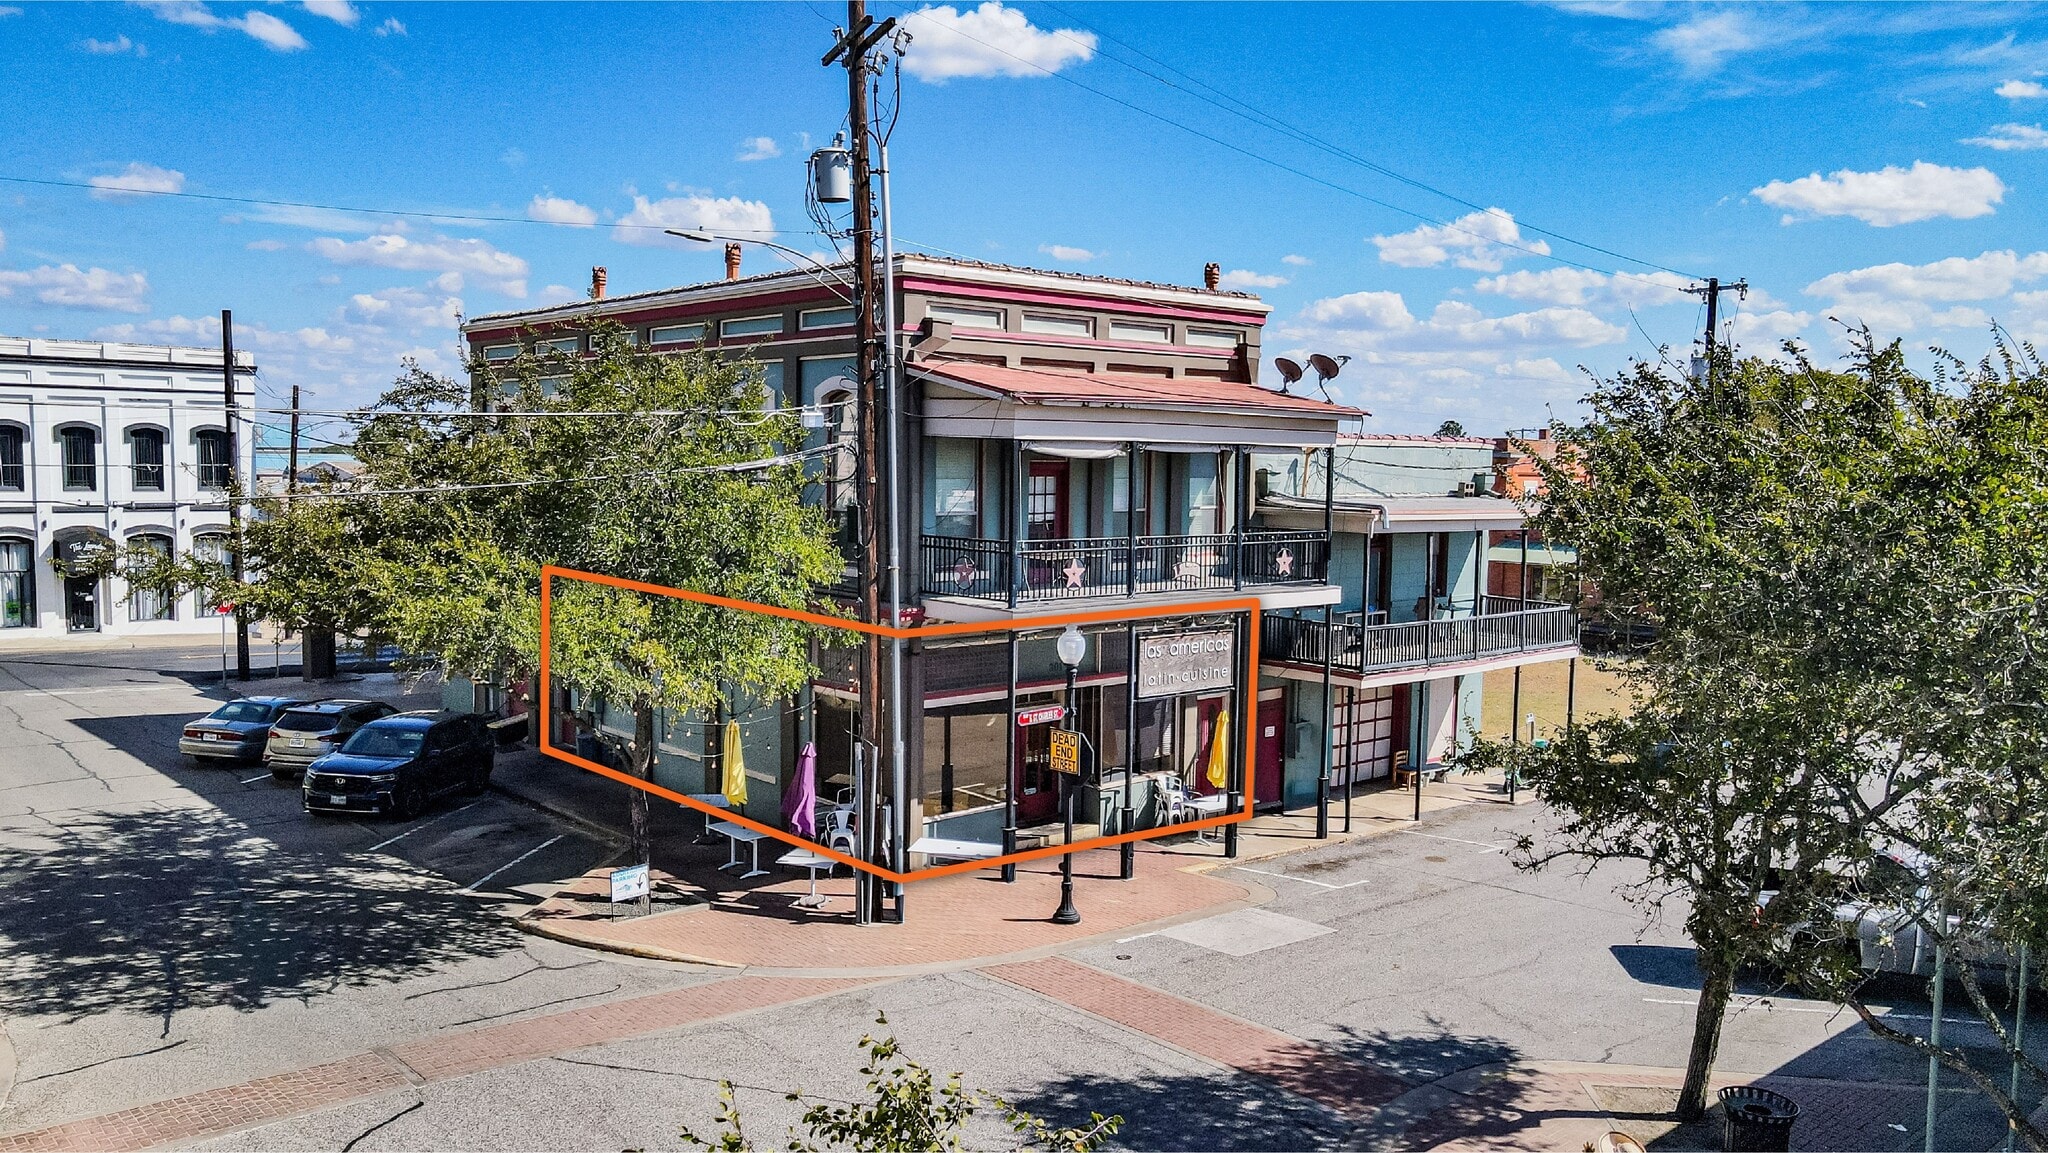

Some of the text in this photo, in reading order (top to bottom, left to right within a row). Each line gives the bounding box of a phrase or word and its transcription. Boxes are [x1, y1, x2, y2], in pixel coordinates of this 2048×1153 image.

[1144, 638, 1229, 659] las americas
[1052, 732, 1076, 747] DEAD
[1055, 745, 1073, 759] END
[1052, 756, 1076, 772] STREET
